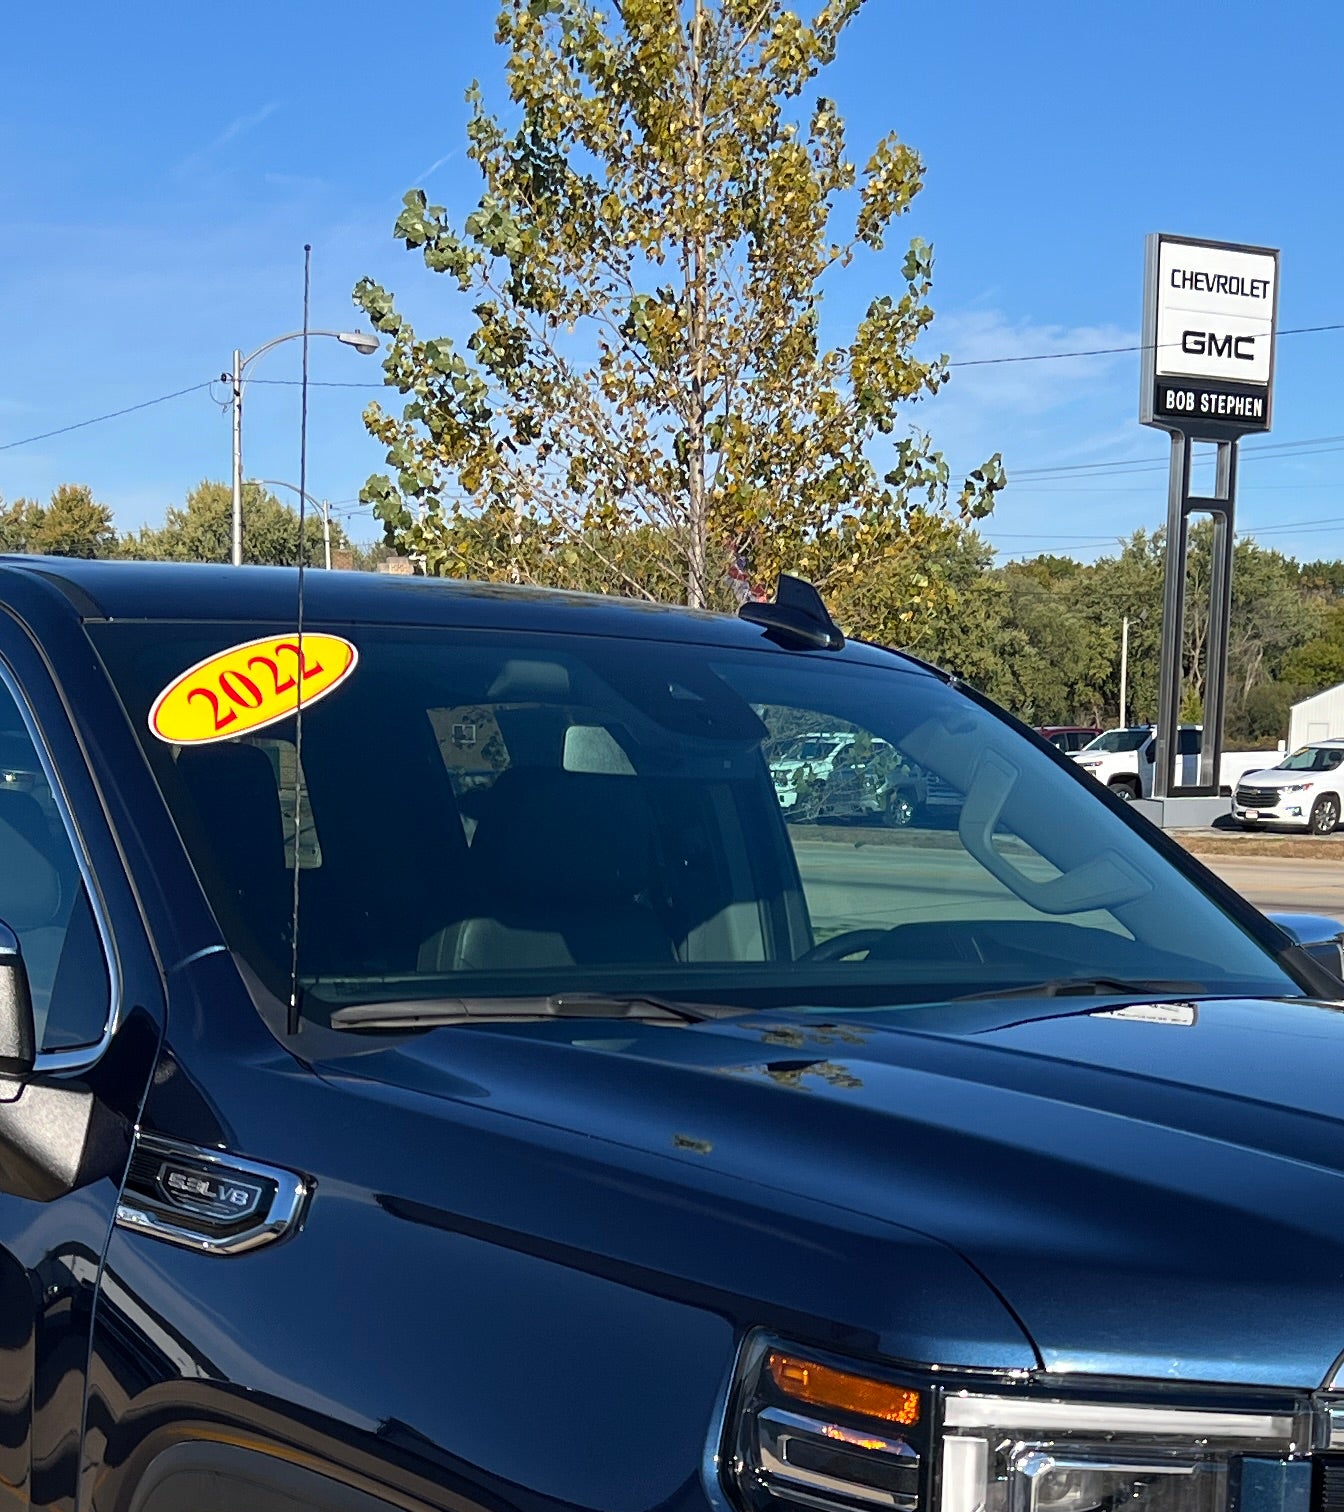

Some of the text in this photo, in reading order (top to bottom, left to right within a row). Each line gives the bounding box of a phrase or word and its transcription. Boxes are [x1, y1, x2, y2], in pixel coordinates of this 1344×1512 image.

[1171, 268, 1271, 299] CHEVROLET
[1181, 330, 1255, 361] GMC
[1165, 389, 1263, 418] BOB STEPHEN
[187, 643, 324, 731] 2022
[218, 1184, 249, 1206] V8
